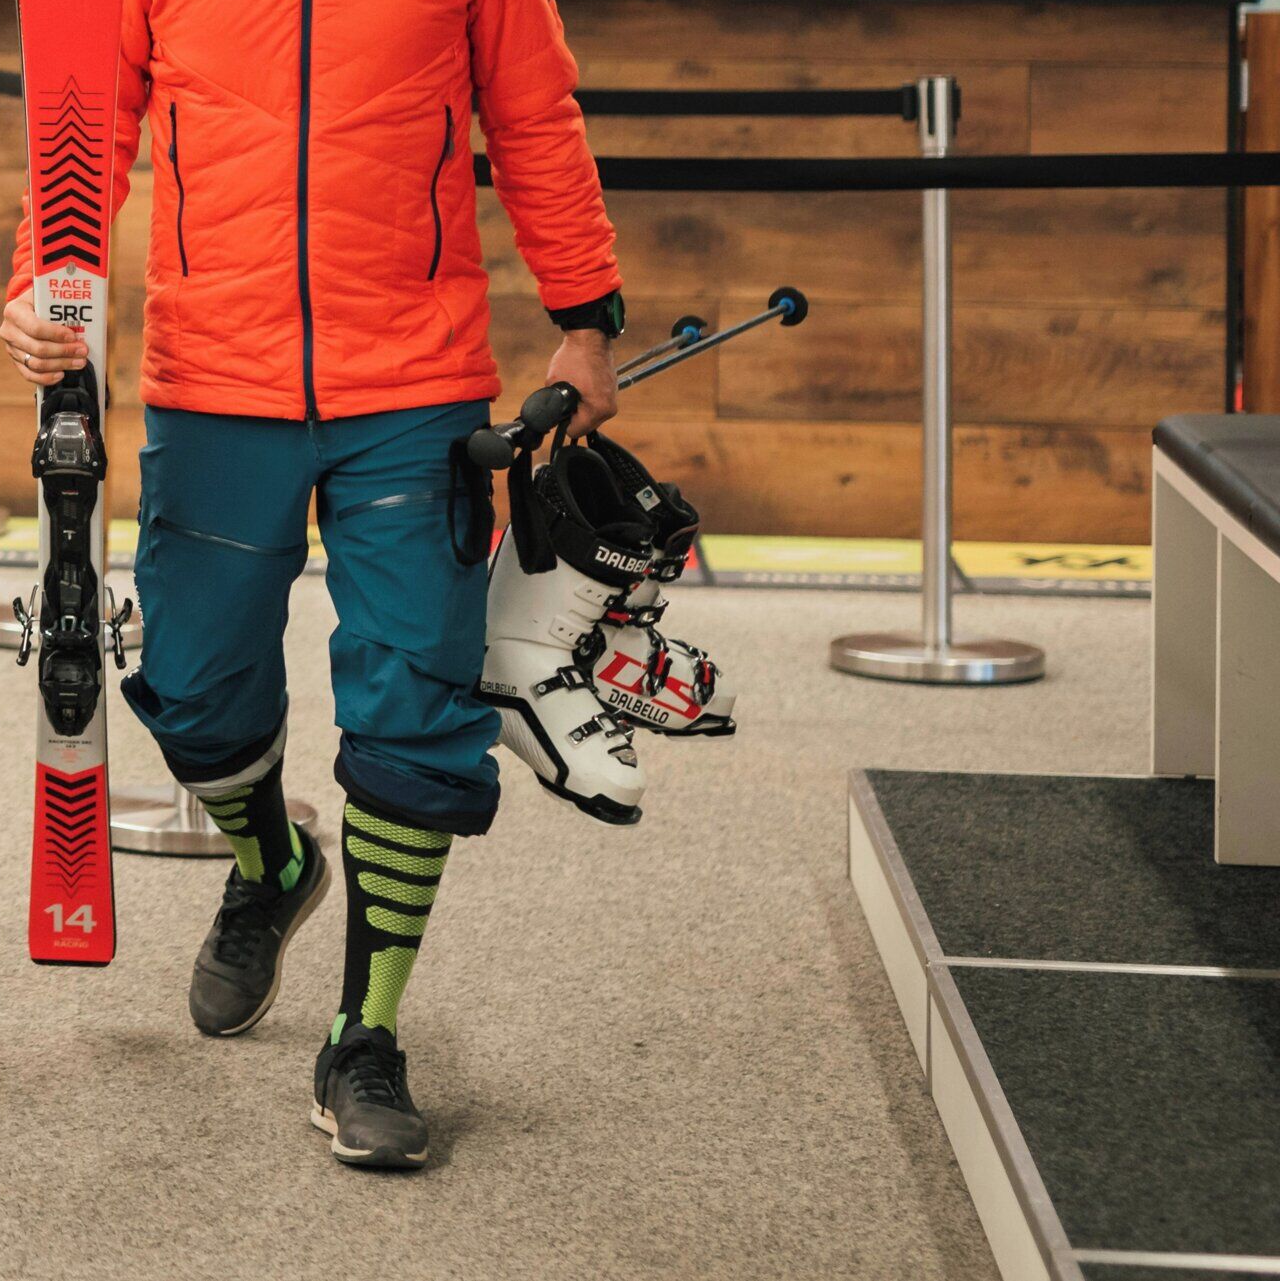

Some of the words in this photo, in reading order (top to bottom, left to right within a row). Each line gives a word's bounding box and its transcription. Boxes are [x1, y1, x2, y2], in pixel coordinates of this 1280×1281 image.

[49, 279, 92, 289] RACE
[50, 289, 92, 300] TIGER
[49, 304, 93, 323] SRC
[608, 688, 670, 724] DALBELLO
[43, 903, 98, 934] 14
